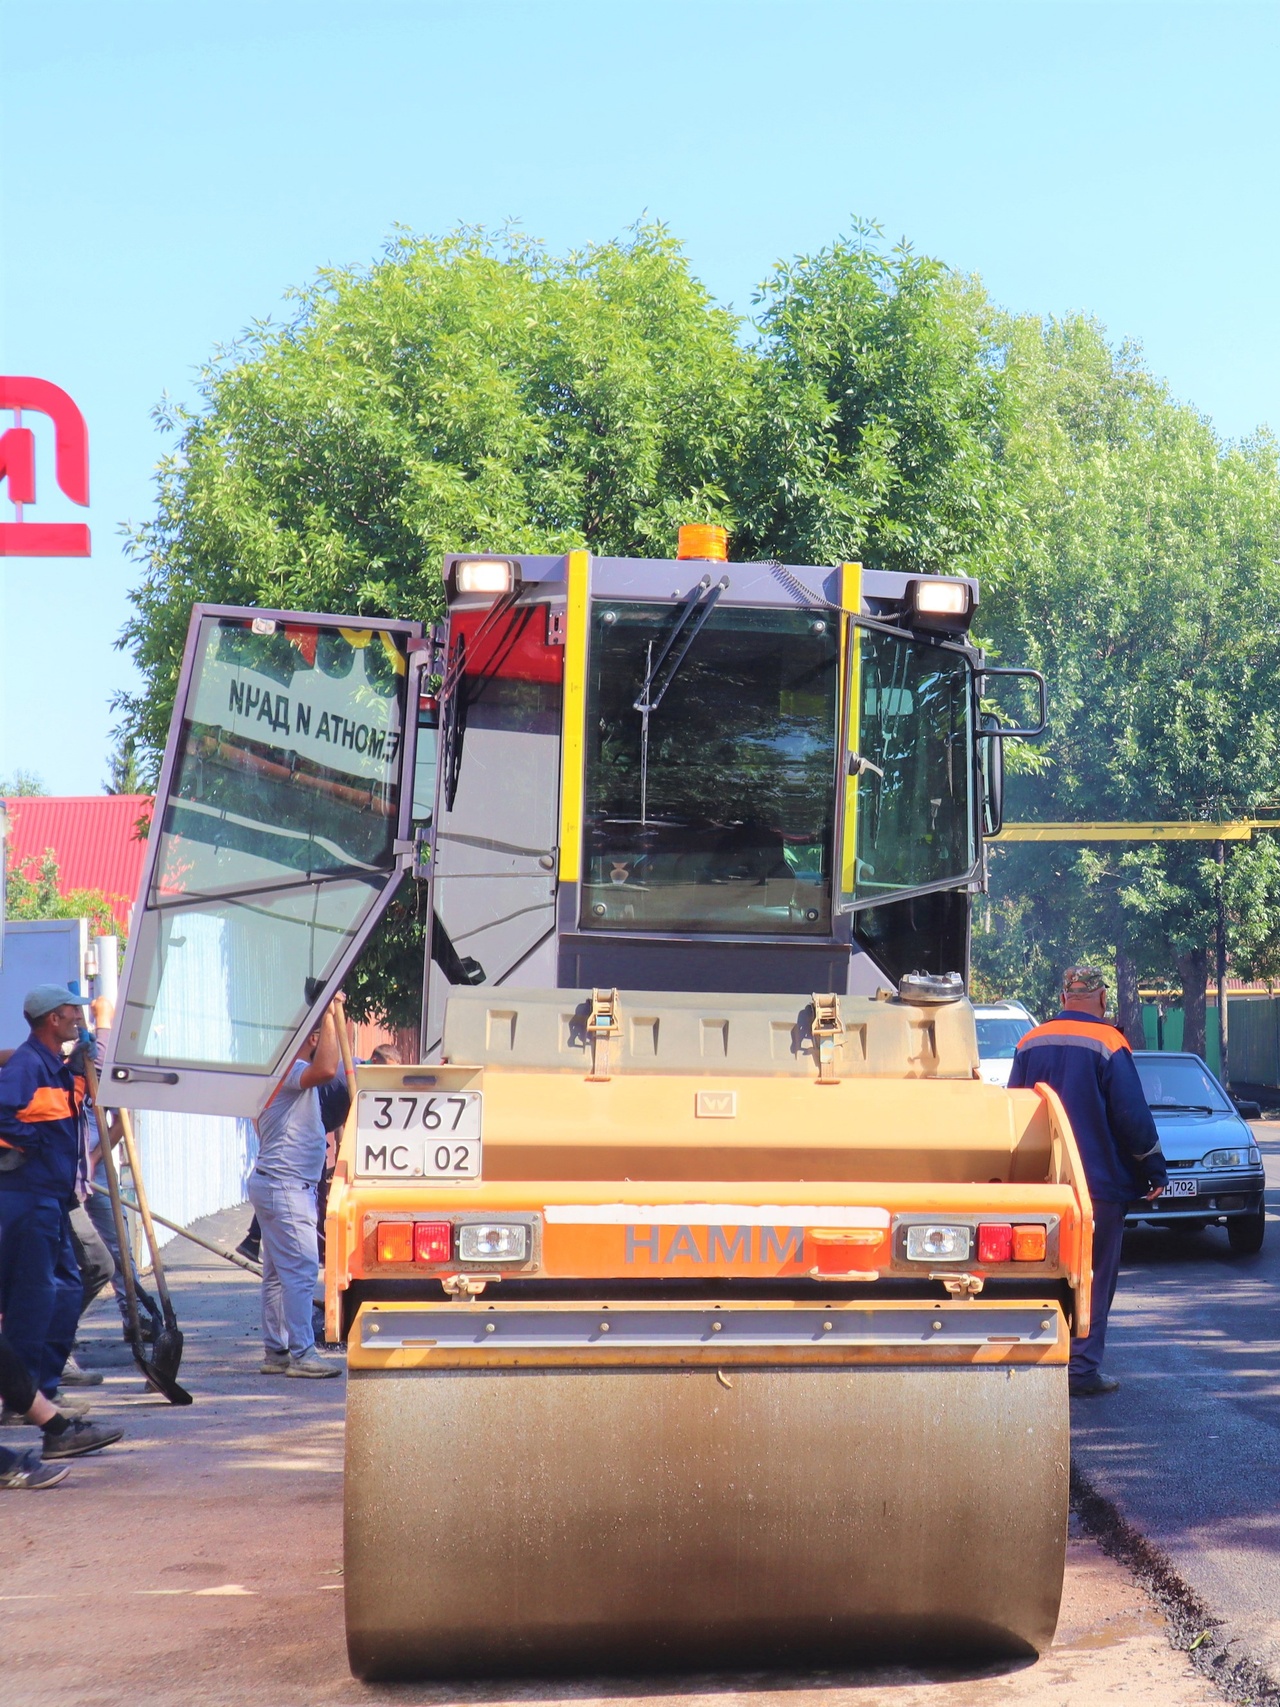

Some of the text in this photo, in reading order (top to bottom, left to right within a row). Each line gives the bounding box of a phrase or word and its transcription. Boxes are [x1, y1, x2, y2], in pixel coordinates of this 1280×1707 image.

[373, 1097, 466, 1130] 3767
[434, 1145, 470, 1171] 02
[1174, 1181, 1193, 1192] 702
[625, 1224, 804, 1263] HAMM
